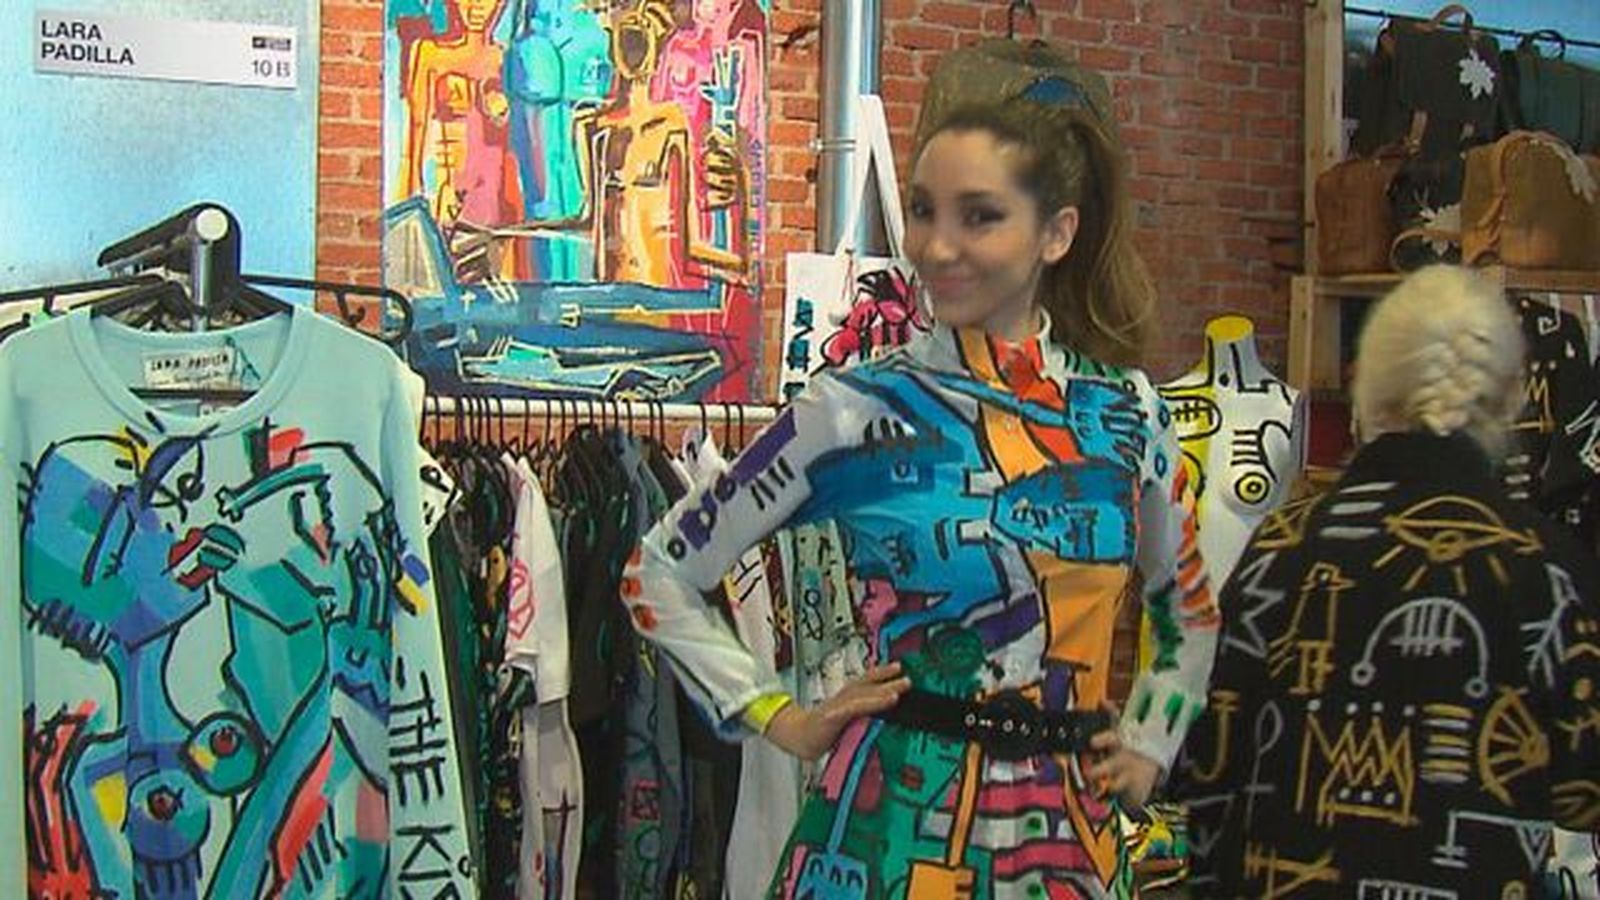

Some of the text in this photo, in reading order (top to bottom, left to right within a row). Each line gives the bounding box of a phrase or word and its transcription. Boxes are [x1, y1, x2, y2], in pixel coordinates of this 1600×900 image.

[41, 19, 102, 40] LARA
[41, 41, 134, 65] PADILLA
[251, 58, 273, 78] 10
